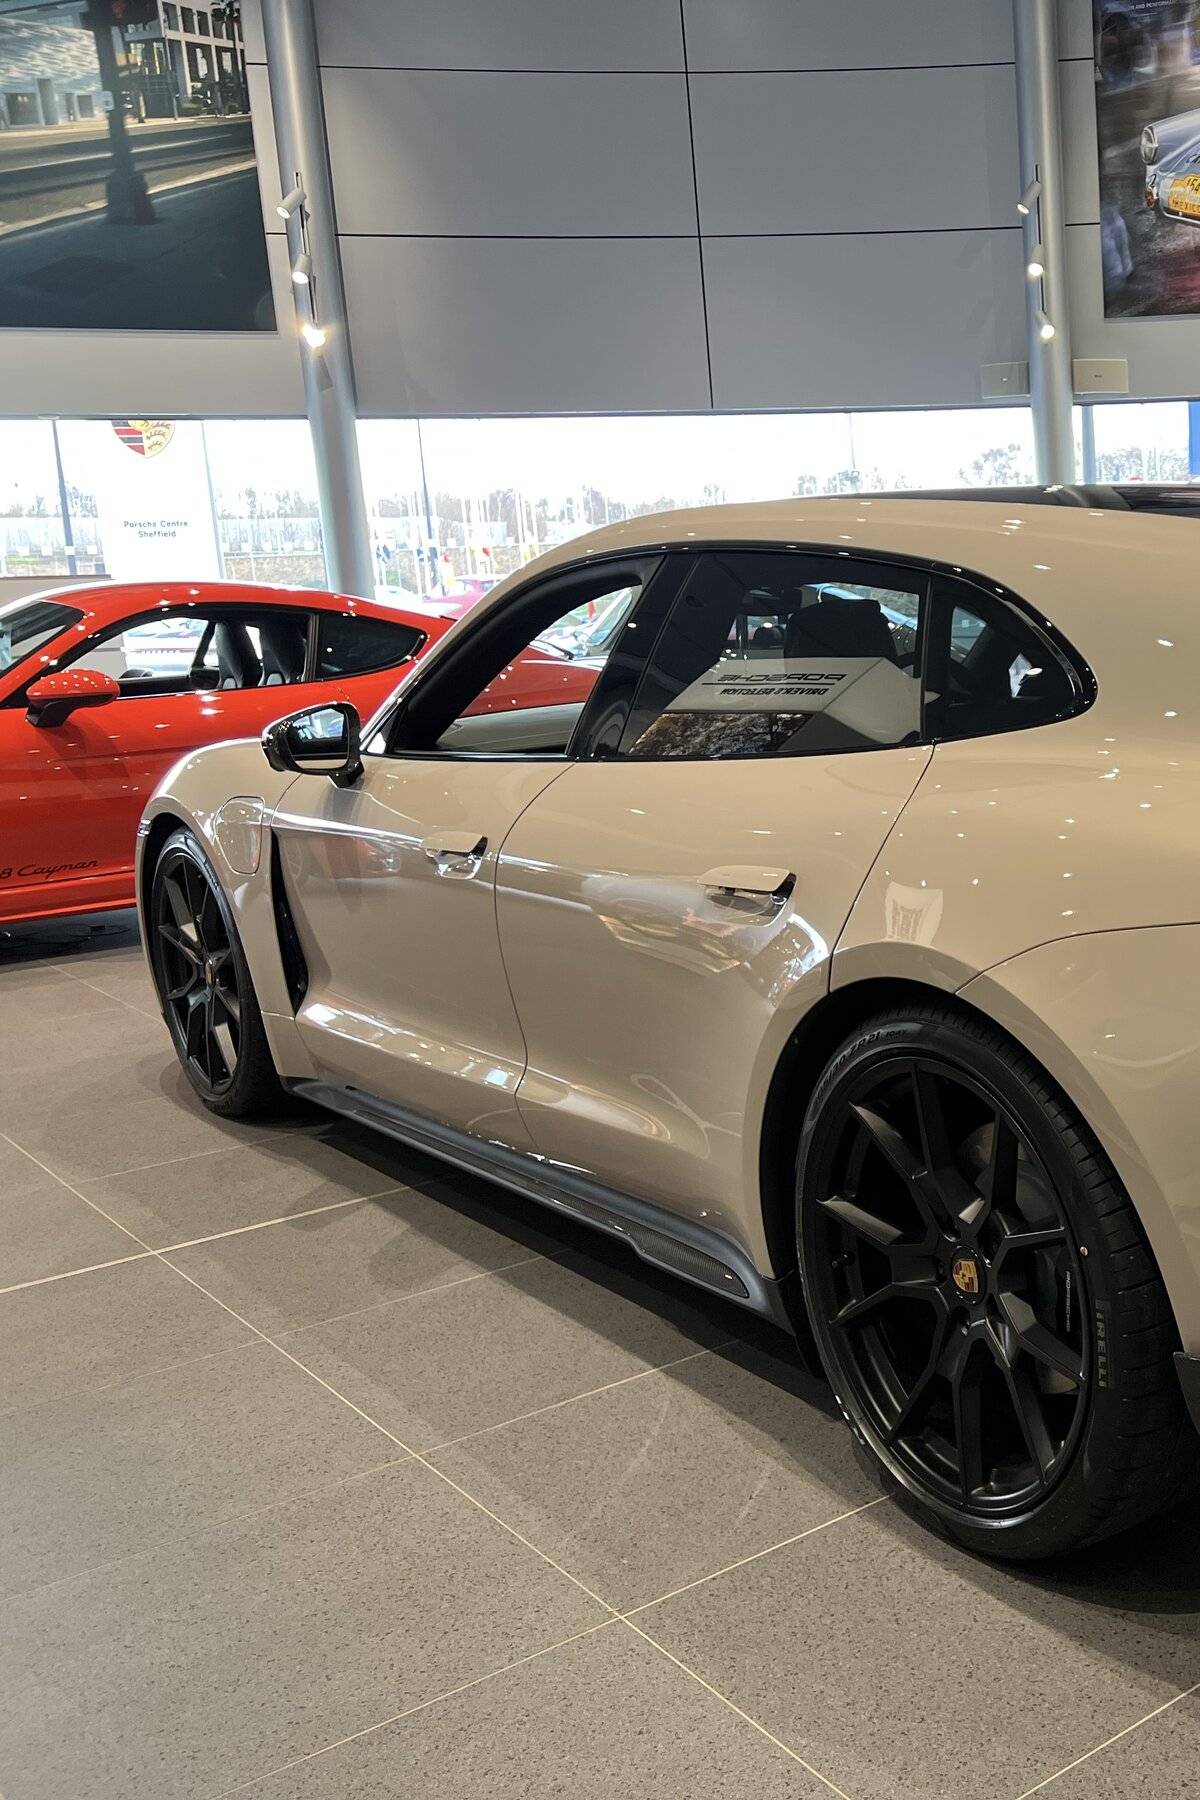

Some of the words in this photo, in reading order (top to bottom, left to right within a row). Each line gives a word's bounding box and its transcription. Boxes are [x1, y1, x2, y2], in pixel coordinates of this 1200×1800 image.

[123, 520, 157, 528] Porsche
[160, 520, 188, 528] Centre
[138, 530, 177, 538] Sheffield
[17, 860, 99, 879] Cayman
